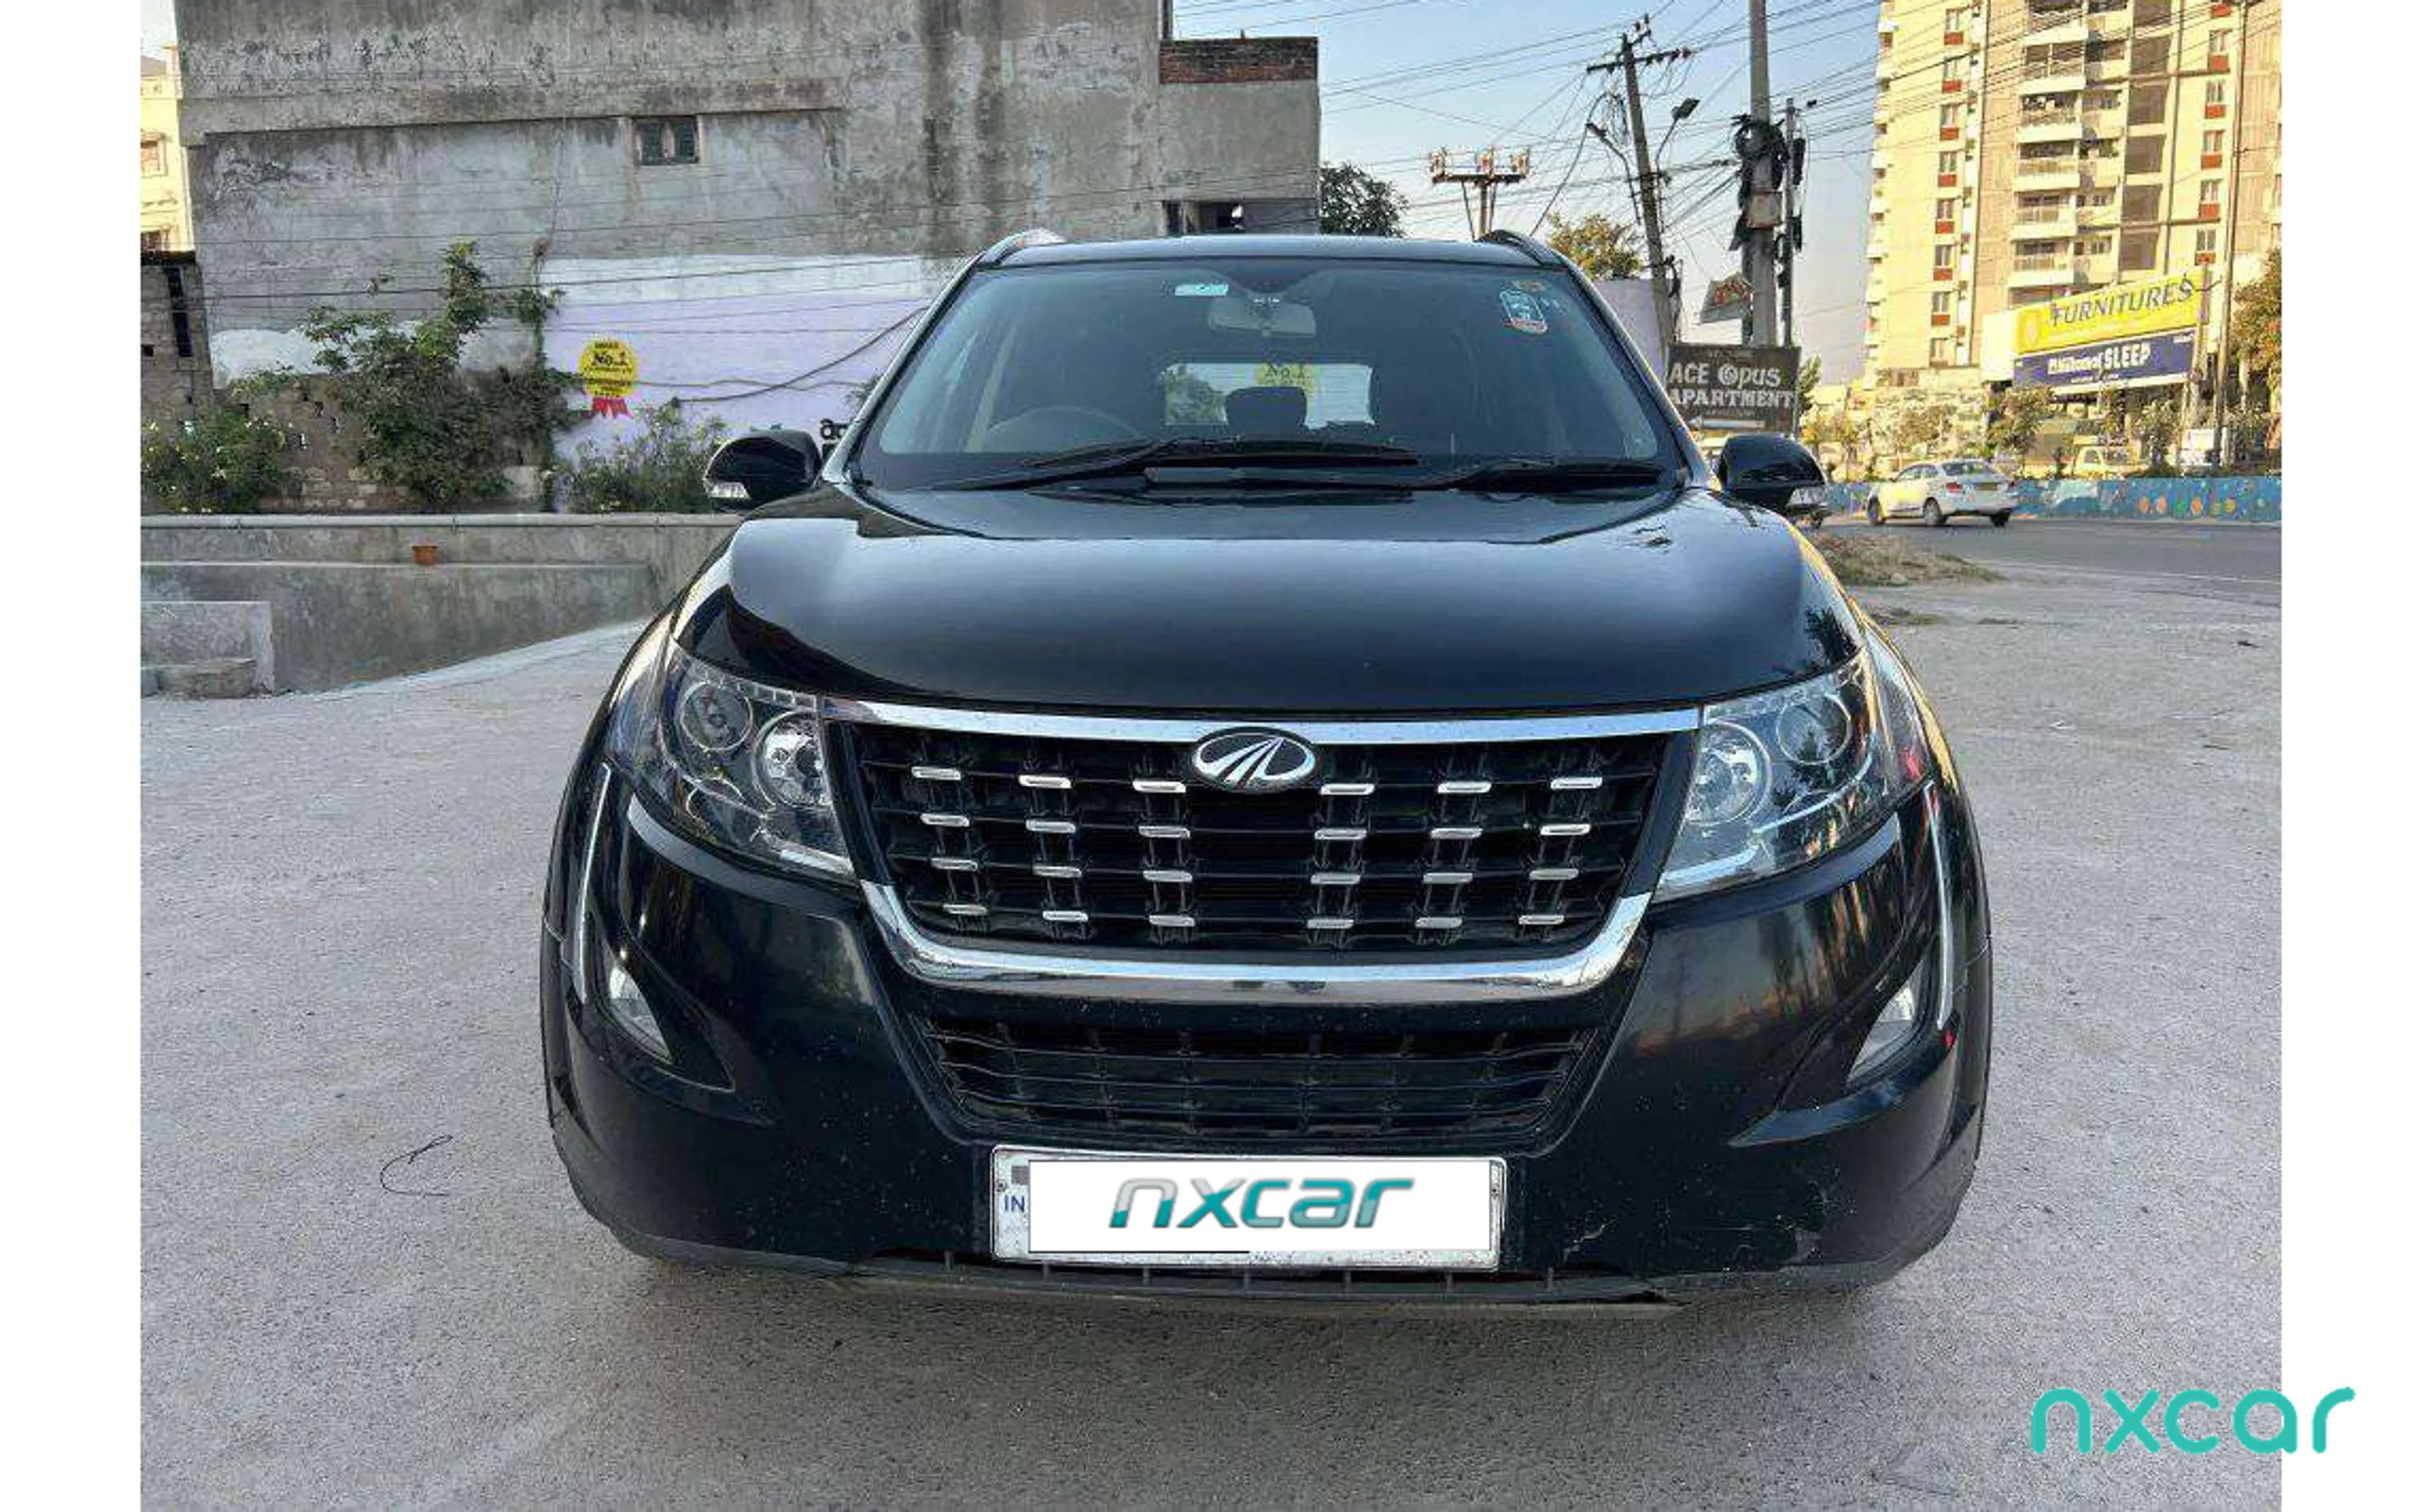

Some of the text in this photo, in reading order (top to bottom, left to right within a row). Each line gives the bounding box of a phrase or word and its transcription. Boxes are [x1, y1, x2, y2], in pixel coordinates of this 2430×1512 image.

[2048, 278, 2195, 326] FURNITURES
[2105, 342, 2151, 369] SLEEP
[1669, 362, 1709, 384] ACE
[1669, 388, 1795, 408] APARTMENT
[1004, 1195, 1025, 1212] IN
